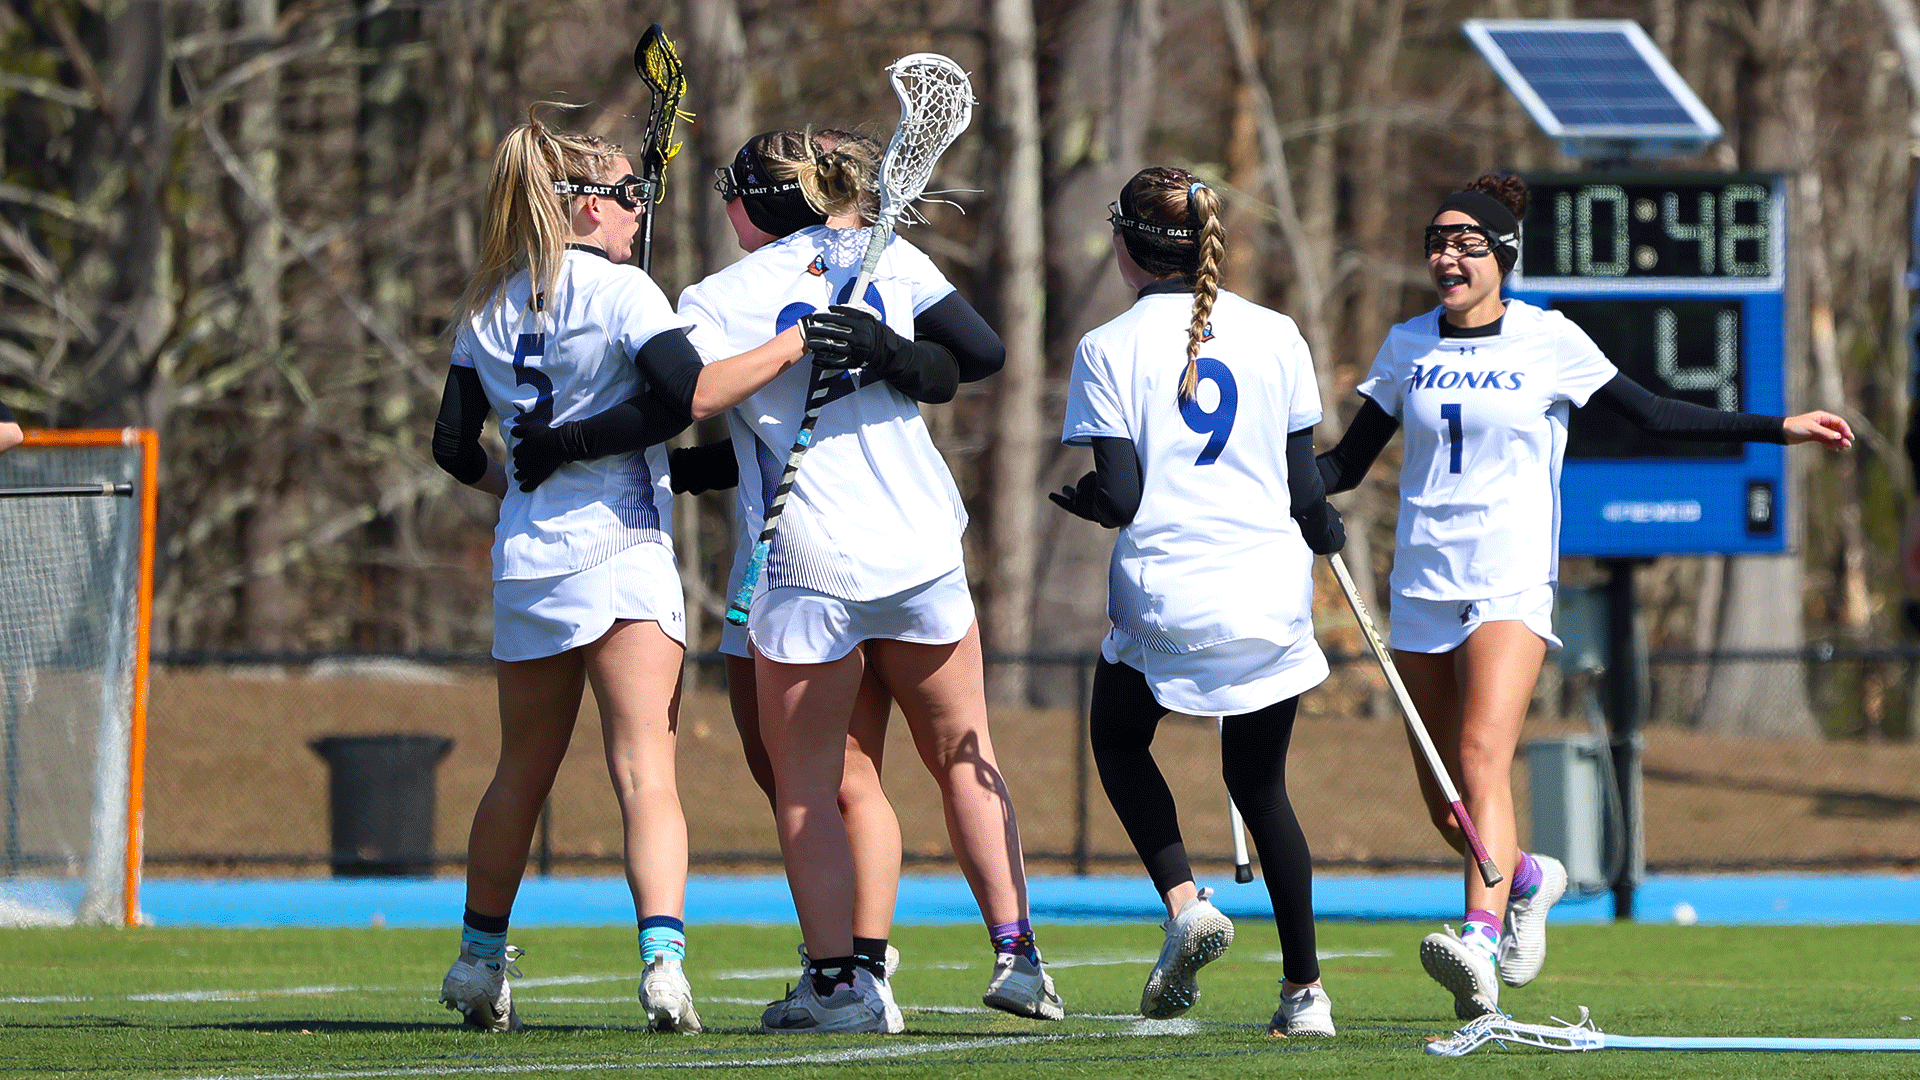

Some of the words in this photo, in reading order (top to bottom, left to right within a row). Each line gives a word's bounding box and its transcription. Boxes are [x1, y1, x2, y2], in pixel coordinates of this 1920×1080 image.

[583, 185, 612, 195] GAIT
[749, 187, 768, 195] GAIT
[782, 182, 800, 191] GAI
[1138, 222, 1163, 234] GAIT
[1167, 228, 1194, 237] GAIT
[512, 333, 555, 425] 5
[1654, 306, 1738, 412] 4
[1177, 357, 1239, 467] 9
[1440, 403, 1464, 475] 1
